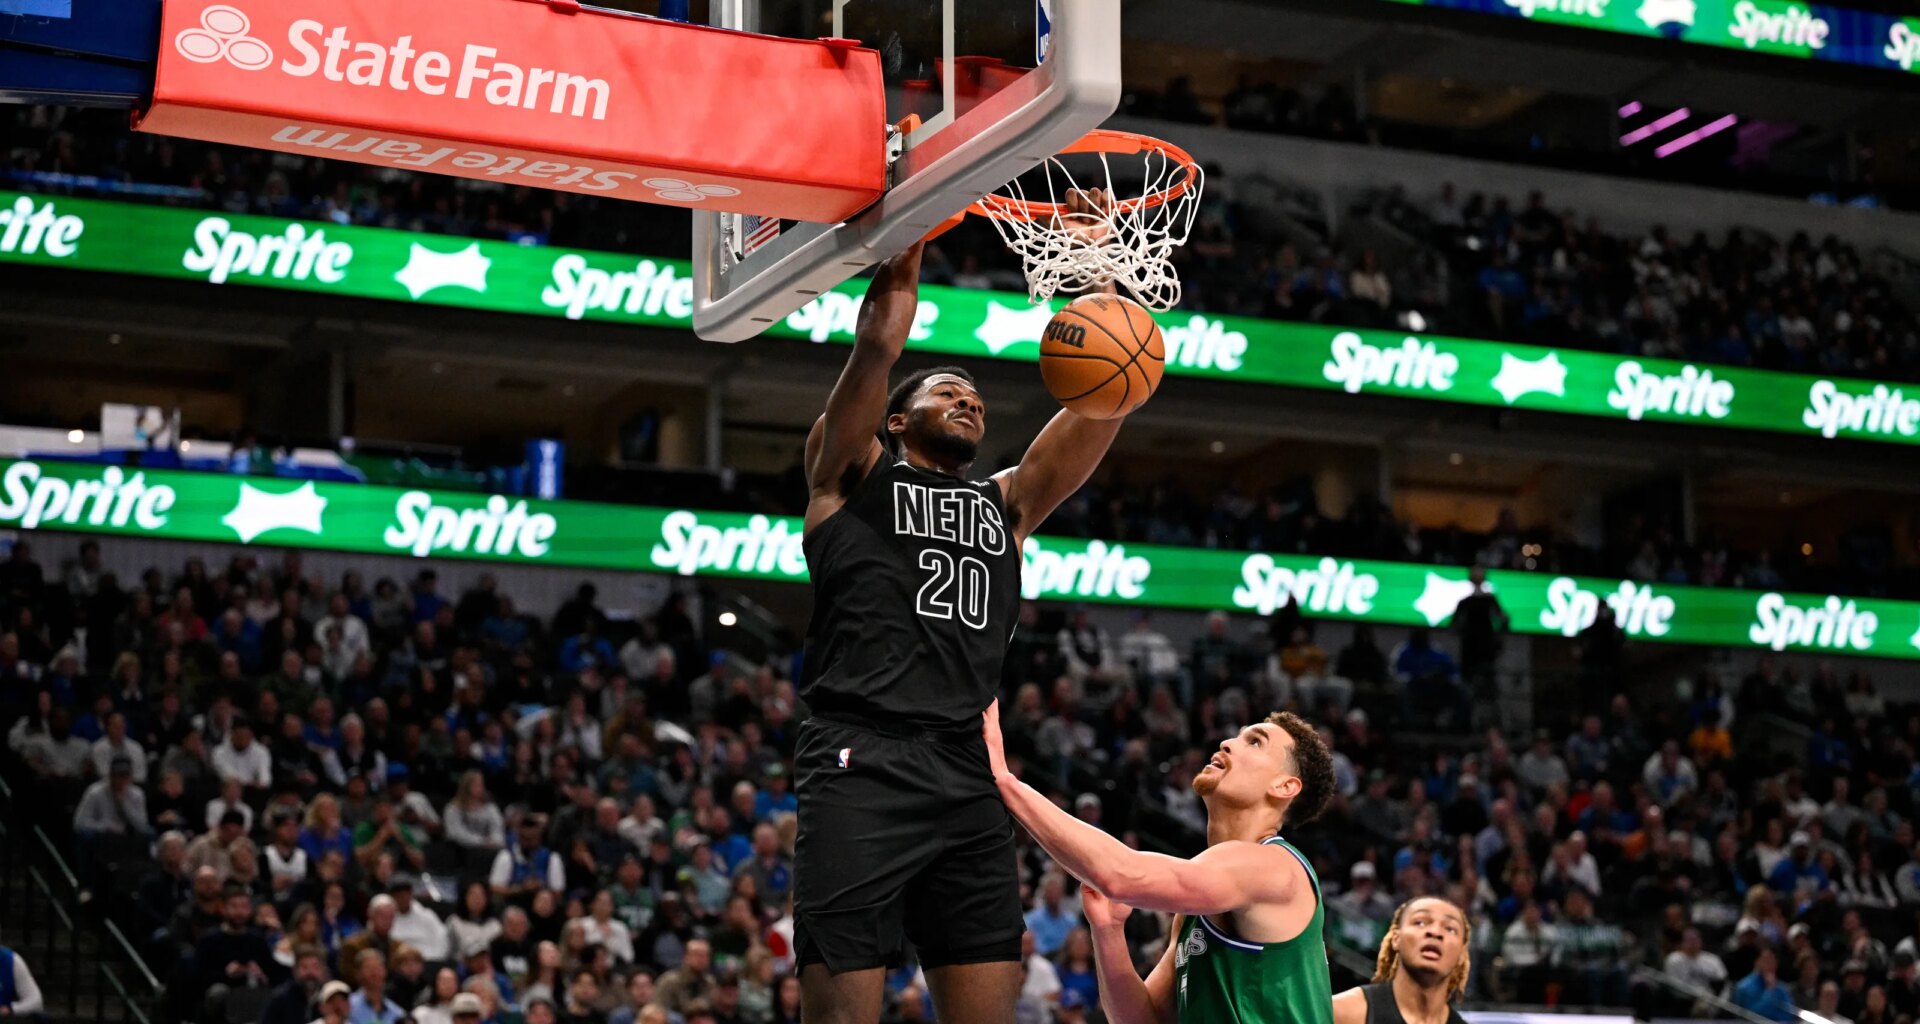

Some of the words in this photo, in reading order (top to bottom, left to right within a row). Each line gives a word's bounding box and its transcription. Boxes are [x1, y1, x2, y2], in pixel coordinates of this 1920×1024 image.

[1728, 0, 1830, 49] Sprite
[0, 196, 84, 257] ite
[182, 217, 353, 284] Sprite
[541, 253, 693, 321] Sprite
[1158, 314, 1249, 372] rite
[1323, 331, 1459, 394] Sprite
[1608, 360, 1734, 420] Sprite
[1802, 379, 1920, 439] Sprite
[0, 461, 176, 529] Sprite
[384, 490, 557, 557] Sprite
[893, 481, 1006, 556] NETS
[650, 510, 808, 576] Sprite
[916, 548, 990, 630] 20
[1233, 553, 1379, 616] Sprite
[1540, 577, 1676, 637] Spite
[1749, 592, 1878, 651] Sprite
